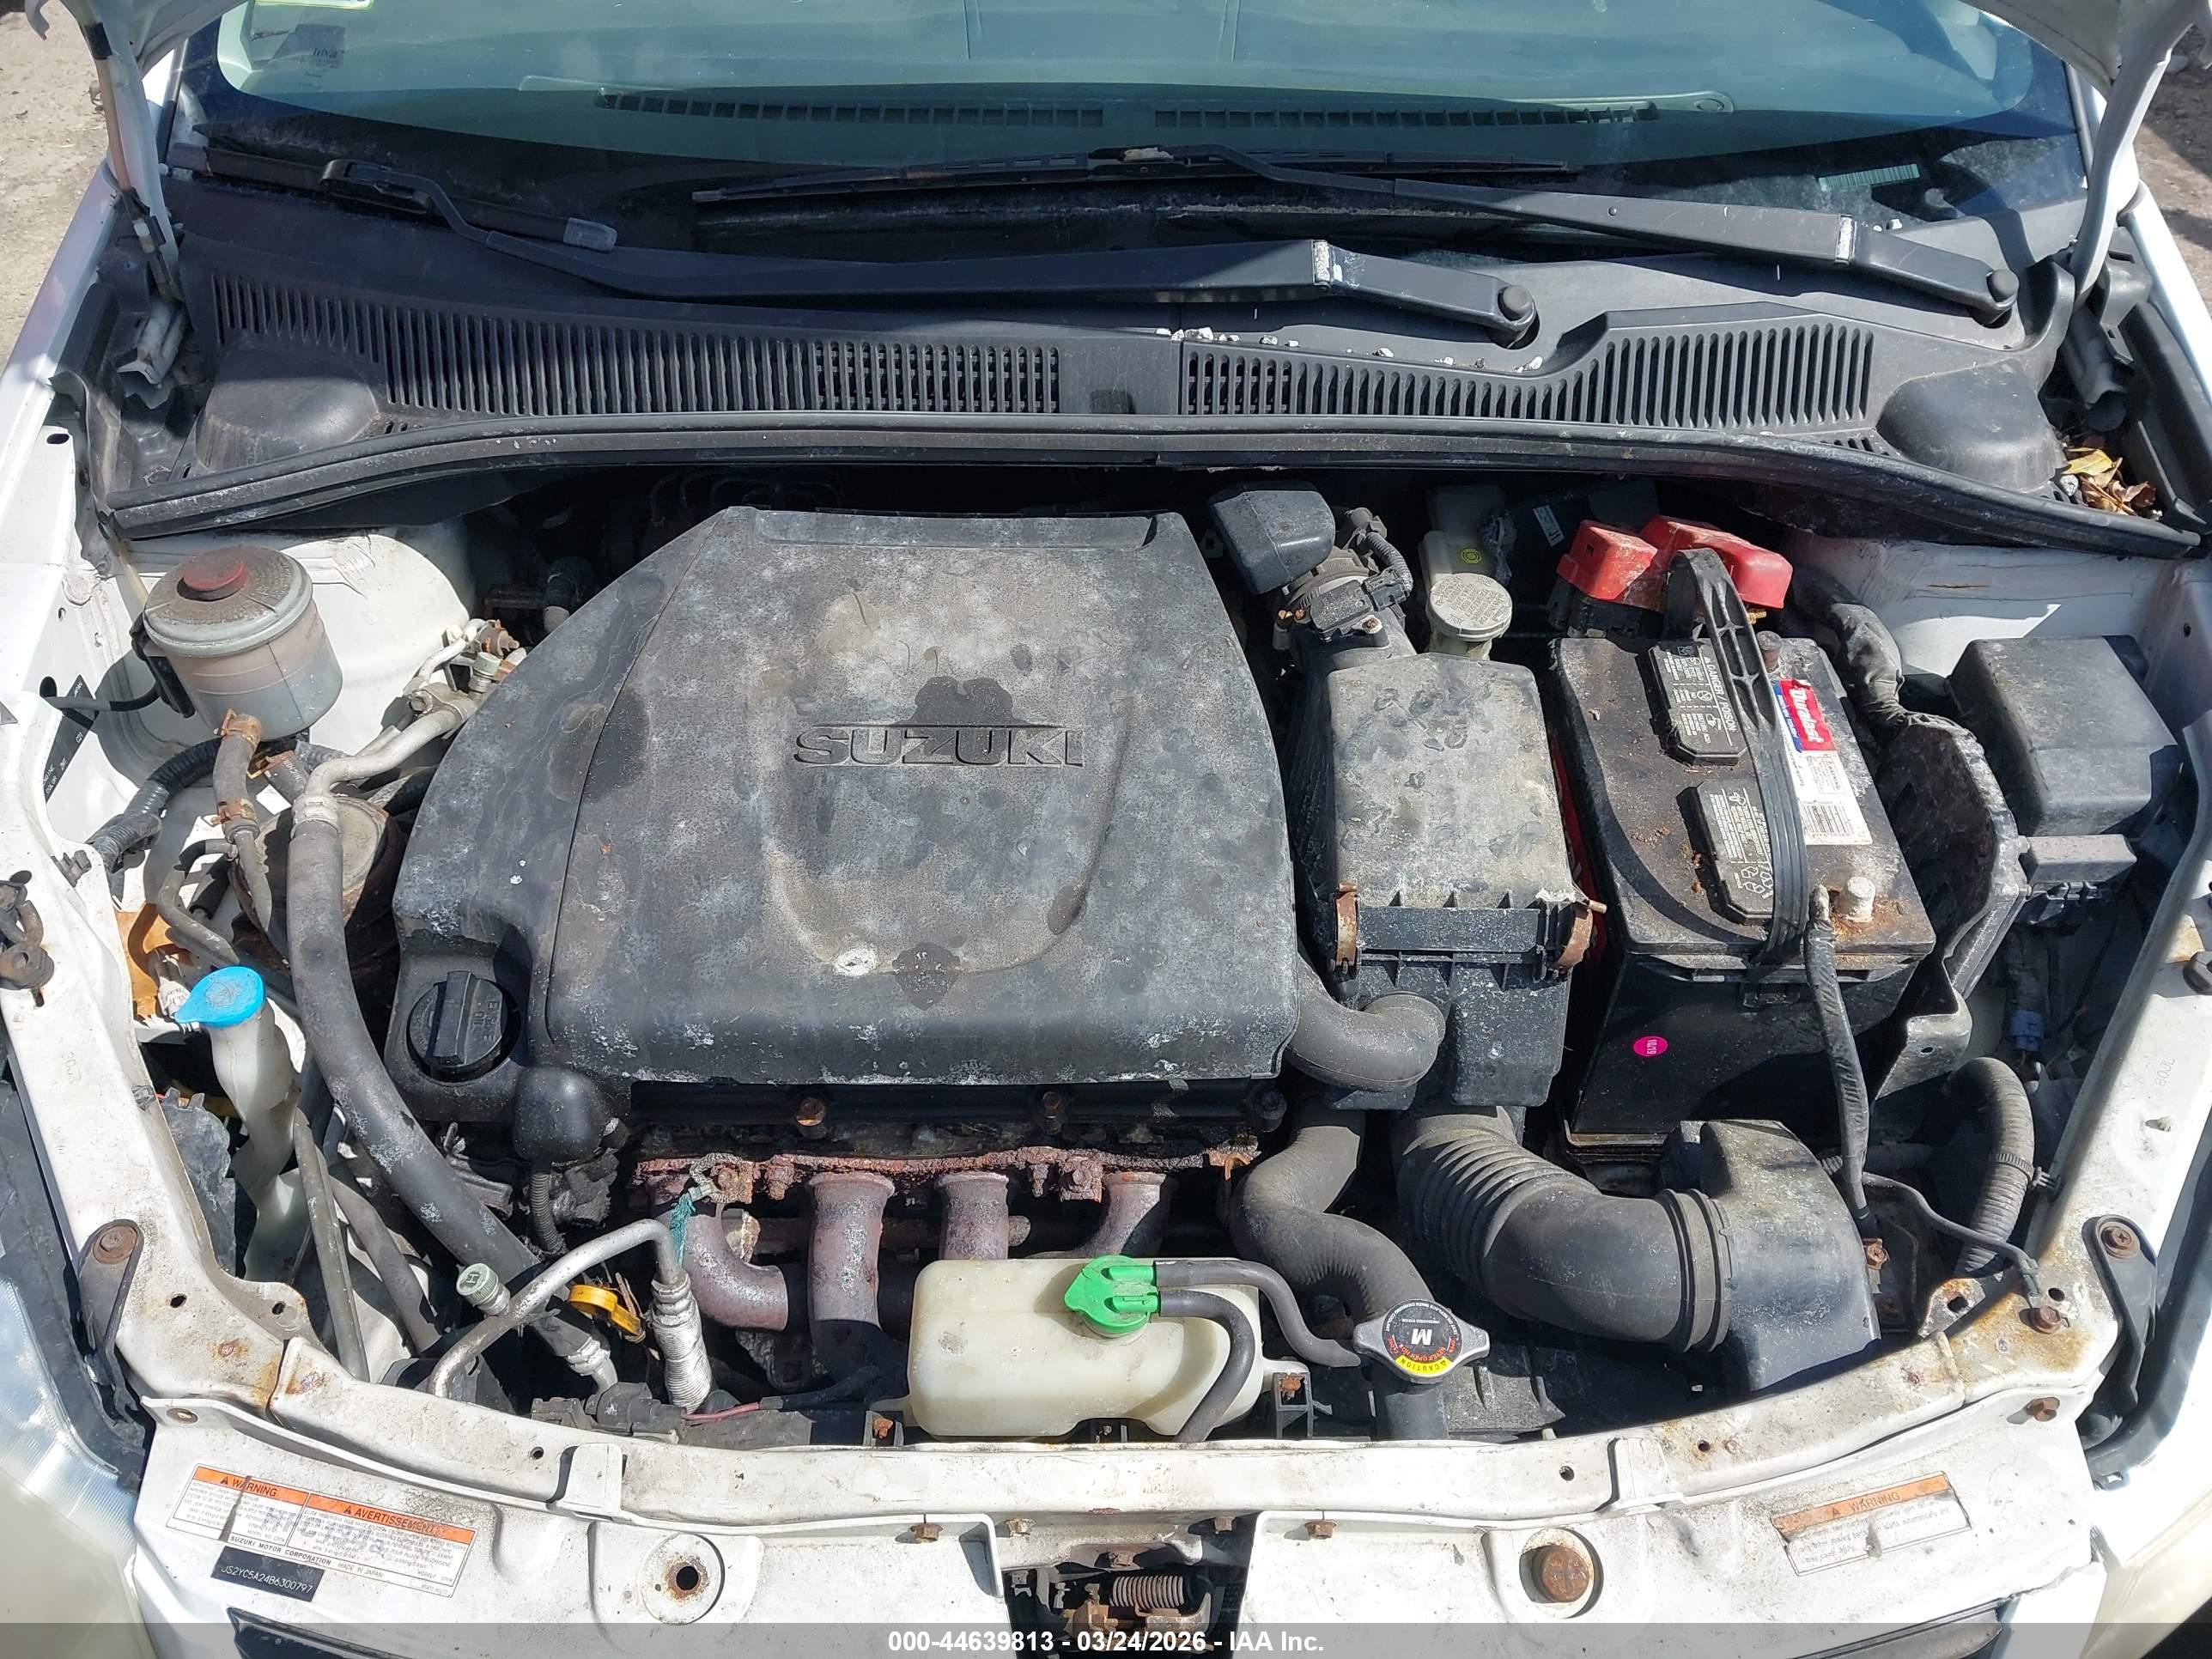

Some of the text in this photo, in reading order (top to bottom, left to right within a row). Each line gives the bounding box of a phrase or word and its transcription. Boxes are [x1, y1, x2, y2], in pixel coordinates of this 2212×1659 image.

[1707, 665, 1724, 695] DANGER
[1719, 702, 1736, 732] POISON
[1789, 688, 1825, 744] Duralast
[793, 727, 1085, 767] SUZUKI
[1647, 1039, 1658, 1054] 10/19
[1411, 1328, 1432, 1346] M
[1428, 1346, 1446, 1360] NEVER
[1401, 1359, 1440, 1371] CAUTION
[231, 1479, 278, 1497] WARNING
[1847, 1491, 1901, 1512] WARNING
[354, 1508, 436, 1534] AVERTISSEMENT
[229, 1534, 257, 1547] SUZUKI
[257, 1541, 282, 1553] MOTOR
[283, 1548, 331, 1565] CORPORATION
[337, 1562, 355, 1571] MADE
[364, 1568, 384, 1578] JAPAN
[220, 1564, 314, 1594] JS2YC5A24B6300797
